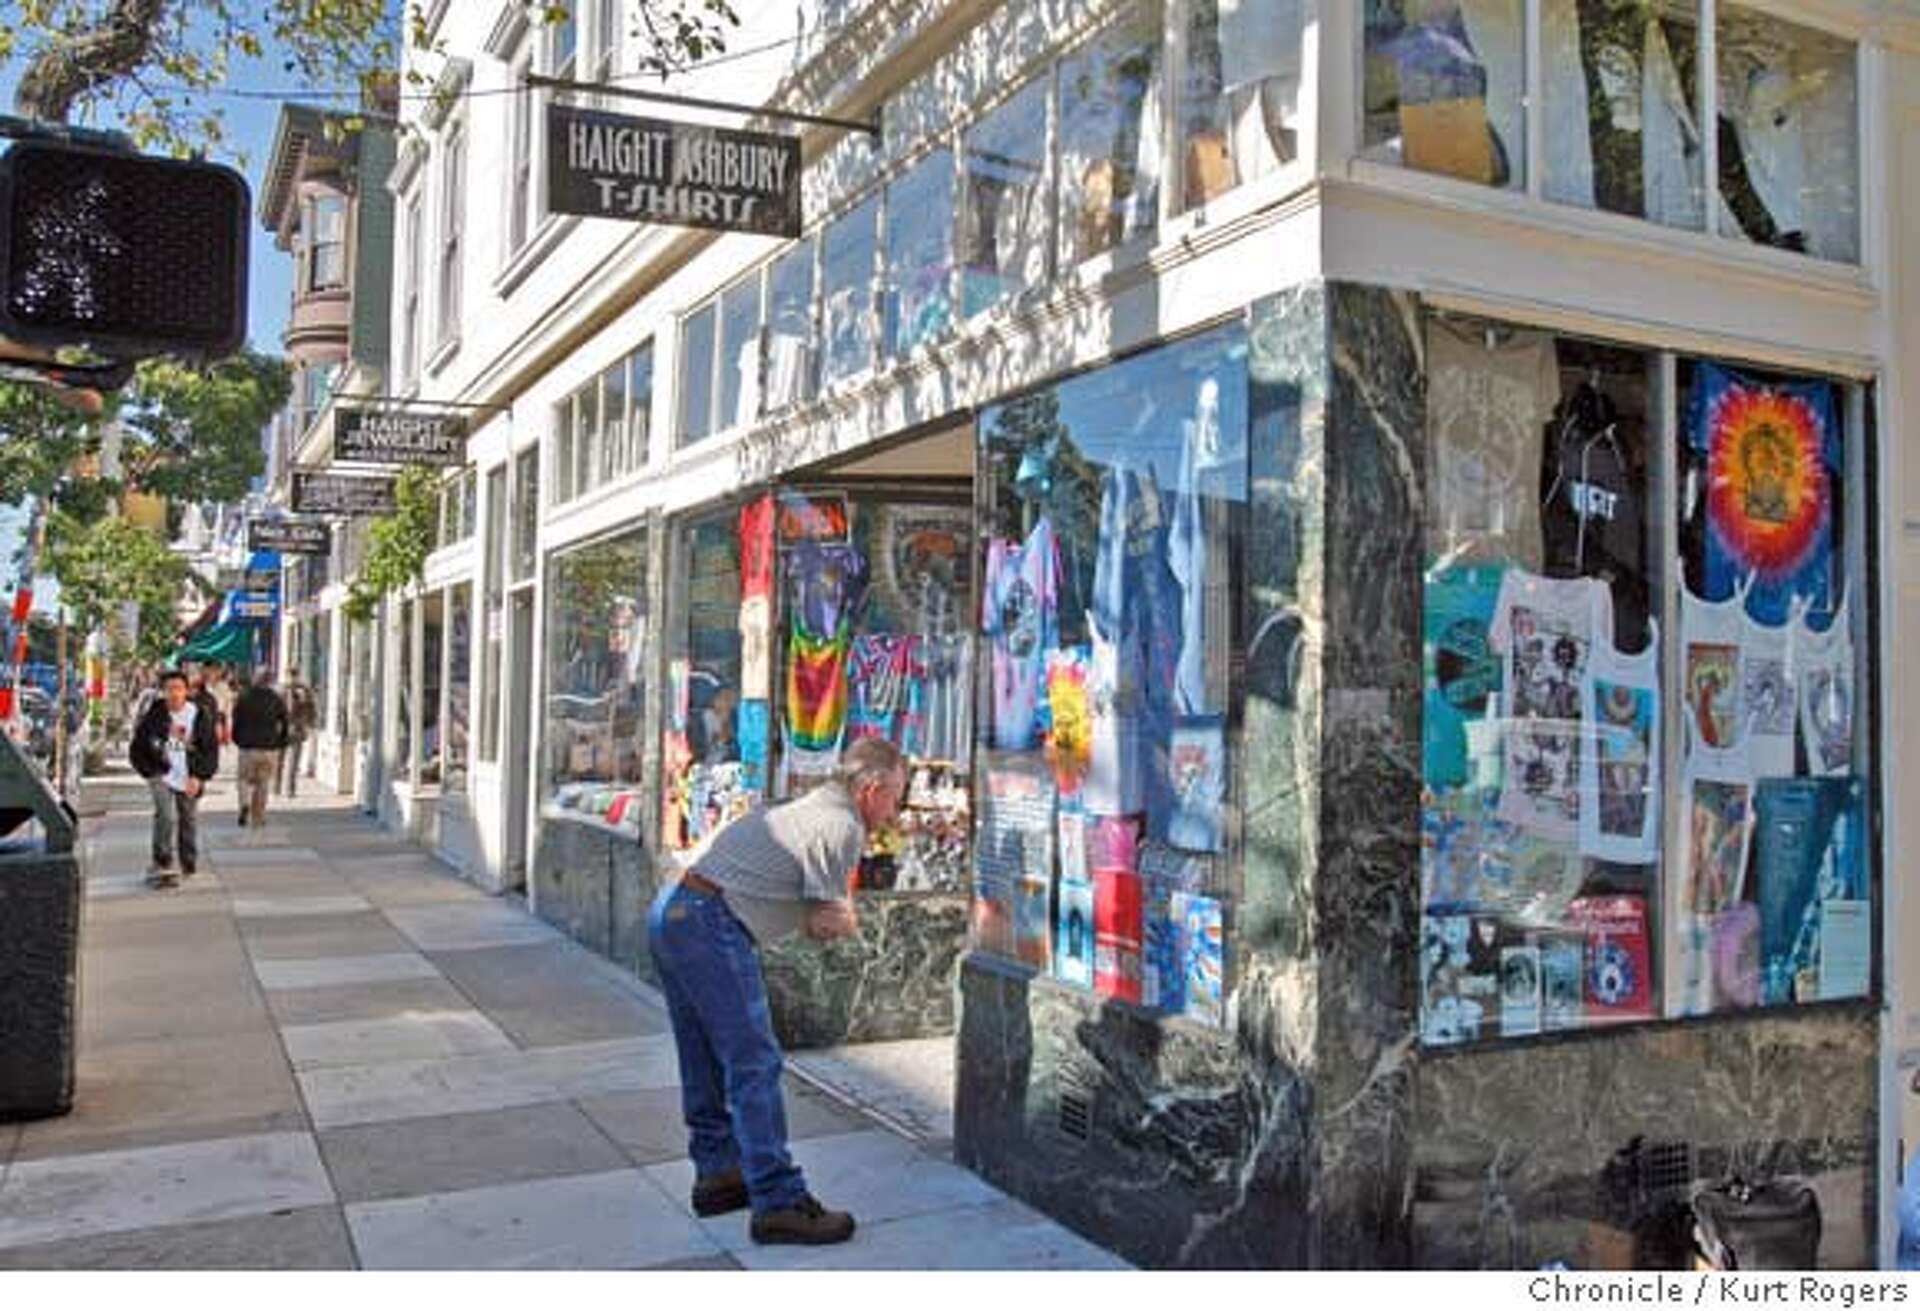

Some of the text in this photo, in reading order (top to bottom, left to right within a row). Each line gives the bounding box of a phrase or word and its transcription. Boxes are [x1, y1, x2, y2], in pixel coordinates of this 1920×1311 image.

[568, 121, 788, 193] HAIGHT ASHBURY
[593, 178, 761, 222] T-SHIRTS
